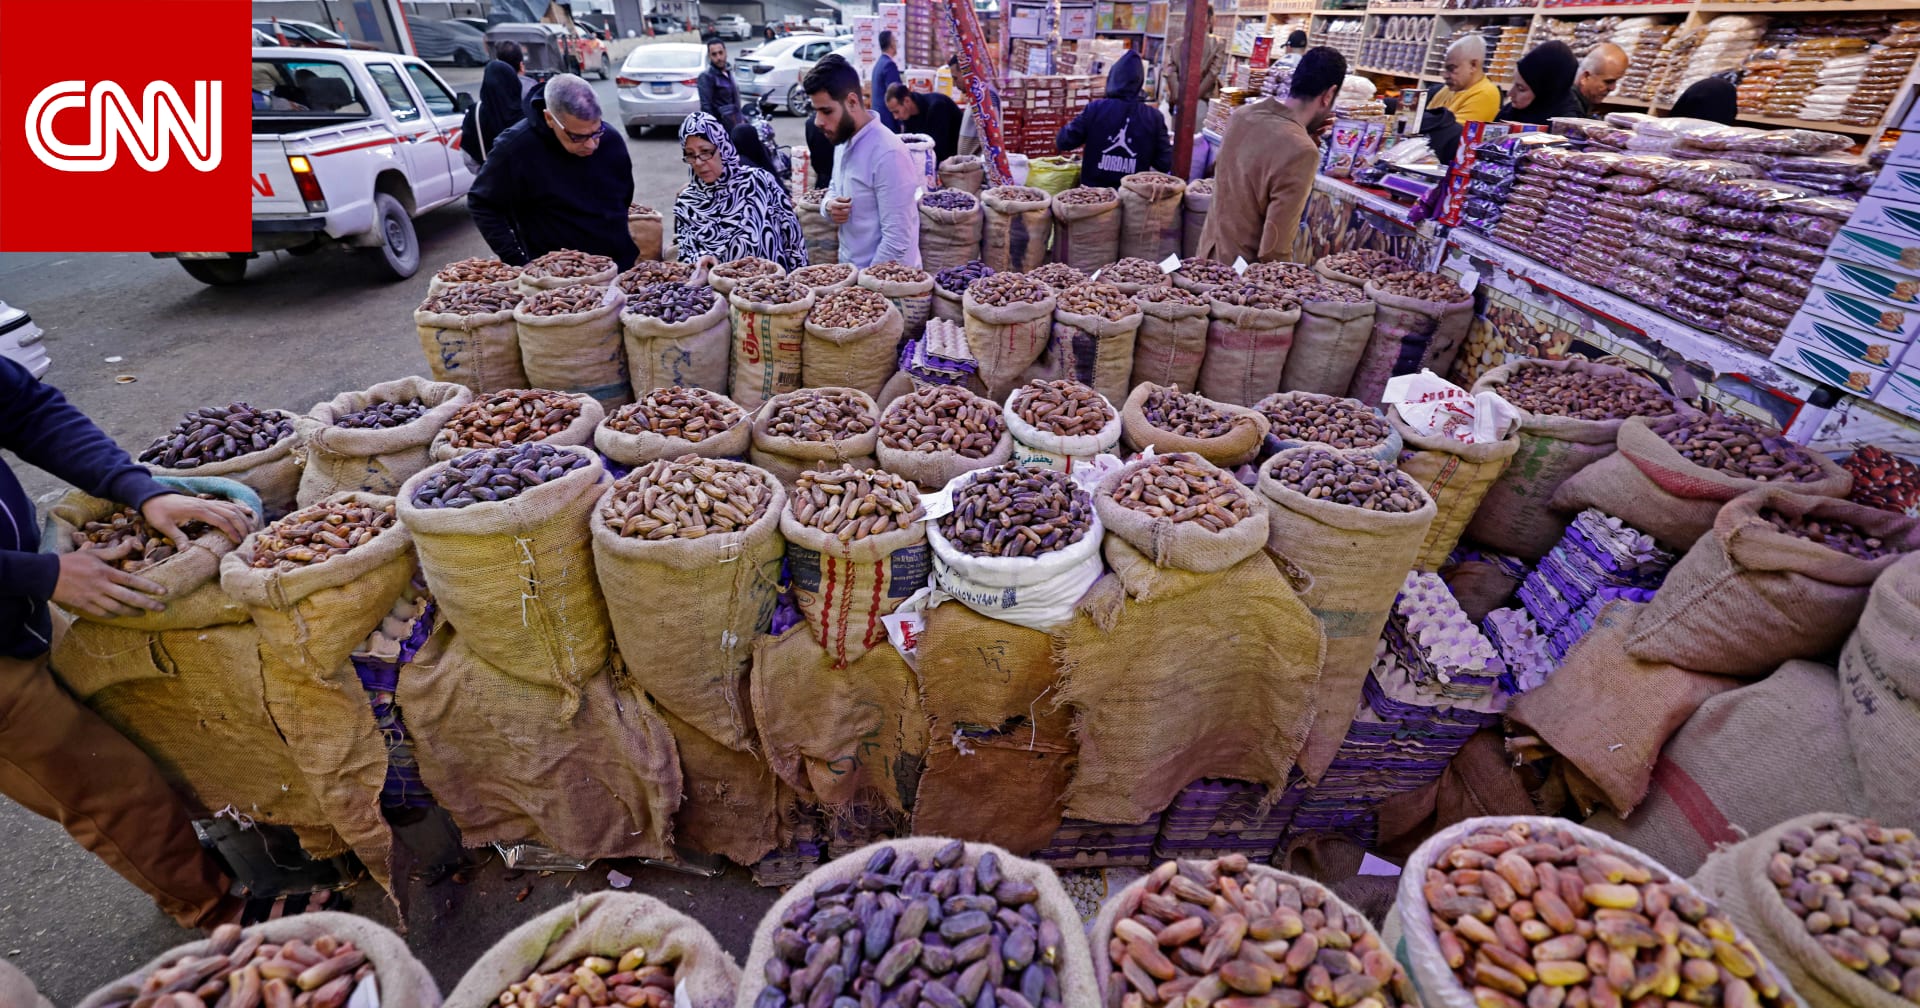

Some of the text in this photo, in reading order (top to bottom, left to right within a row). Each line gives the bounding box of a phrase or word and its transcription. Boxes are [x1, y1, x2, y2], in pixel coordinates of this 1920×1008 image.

[1097, 154, 1137, 174] JORDAN
[1021, 454, 1032, 466] في
[1032, 454, 1053, 466] يحفظ
